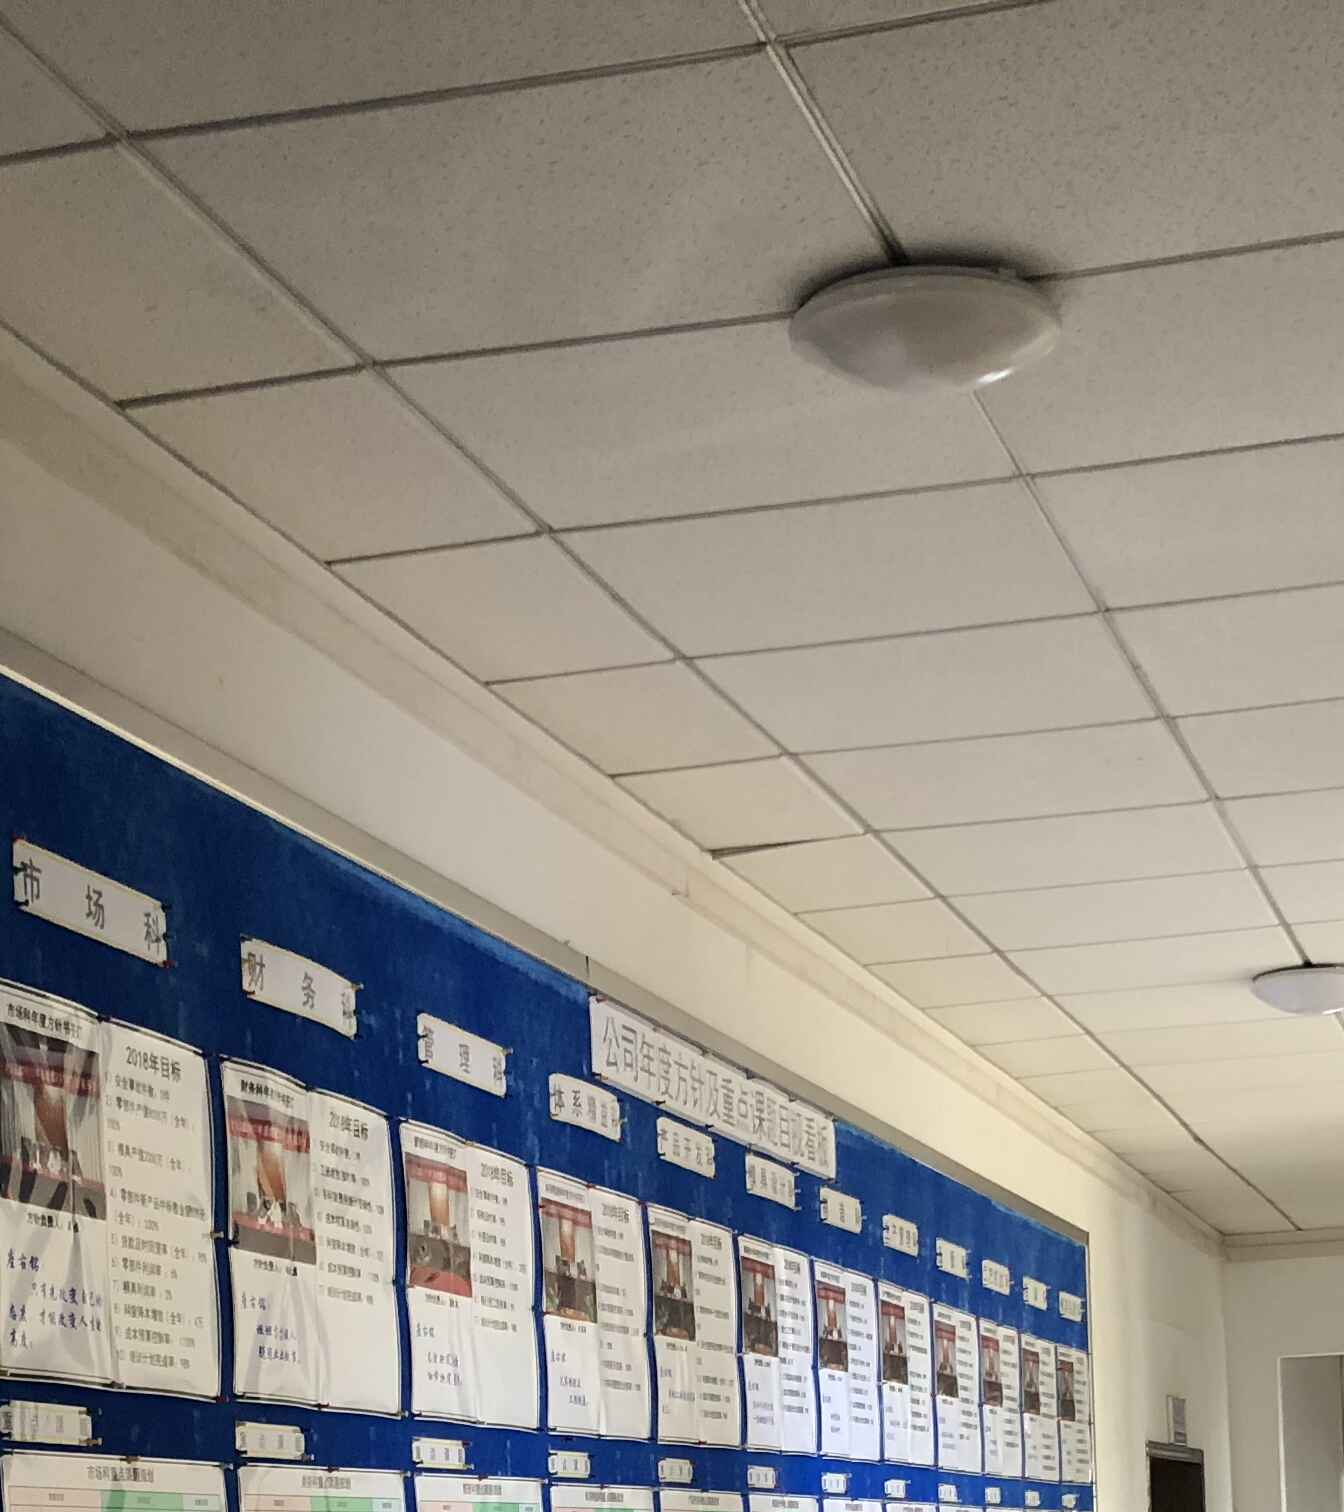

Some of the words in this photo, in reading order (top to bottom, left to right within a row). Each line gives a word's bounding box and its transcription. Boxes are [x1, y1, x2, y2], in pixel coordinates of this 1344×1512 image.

[19, 858, 164, 954] 市场科
[125, 1046, 182, 1083] 2018年目标
